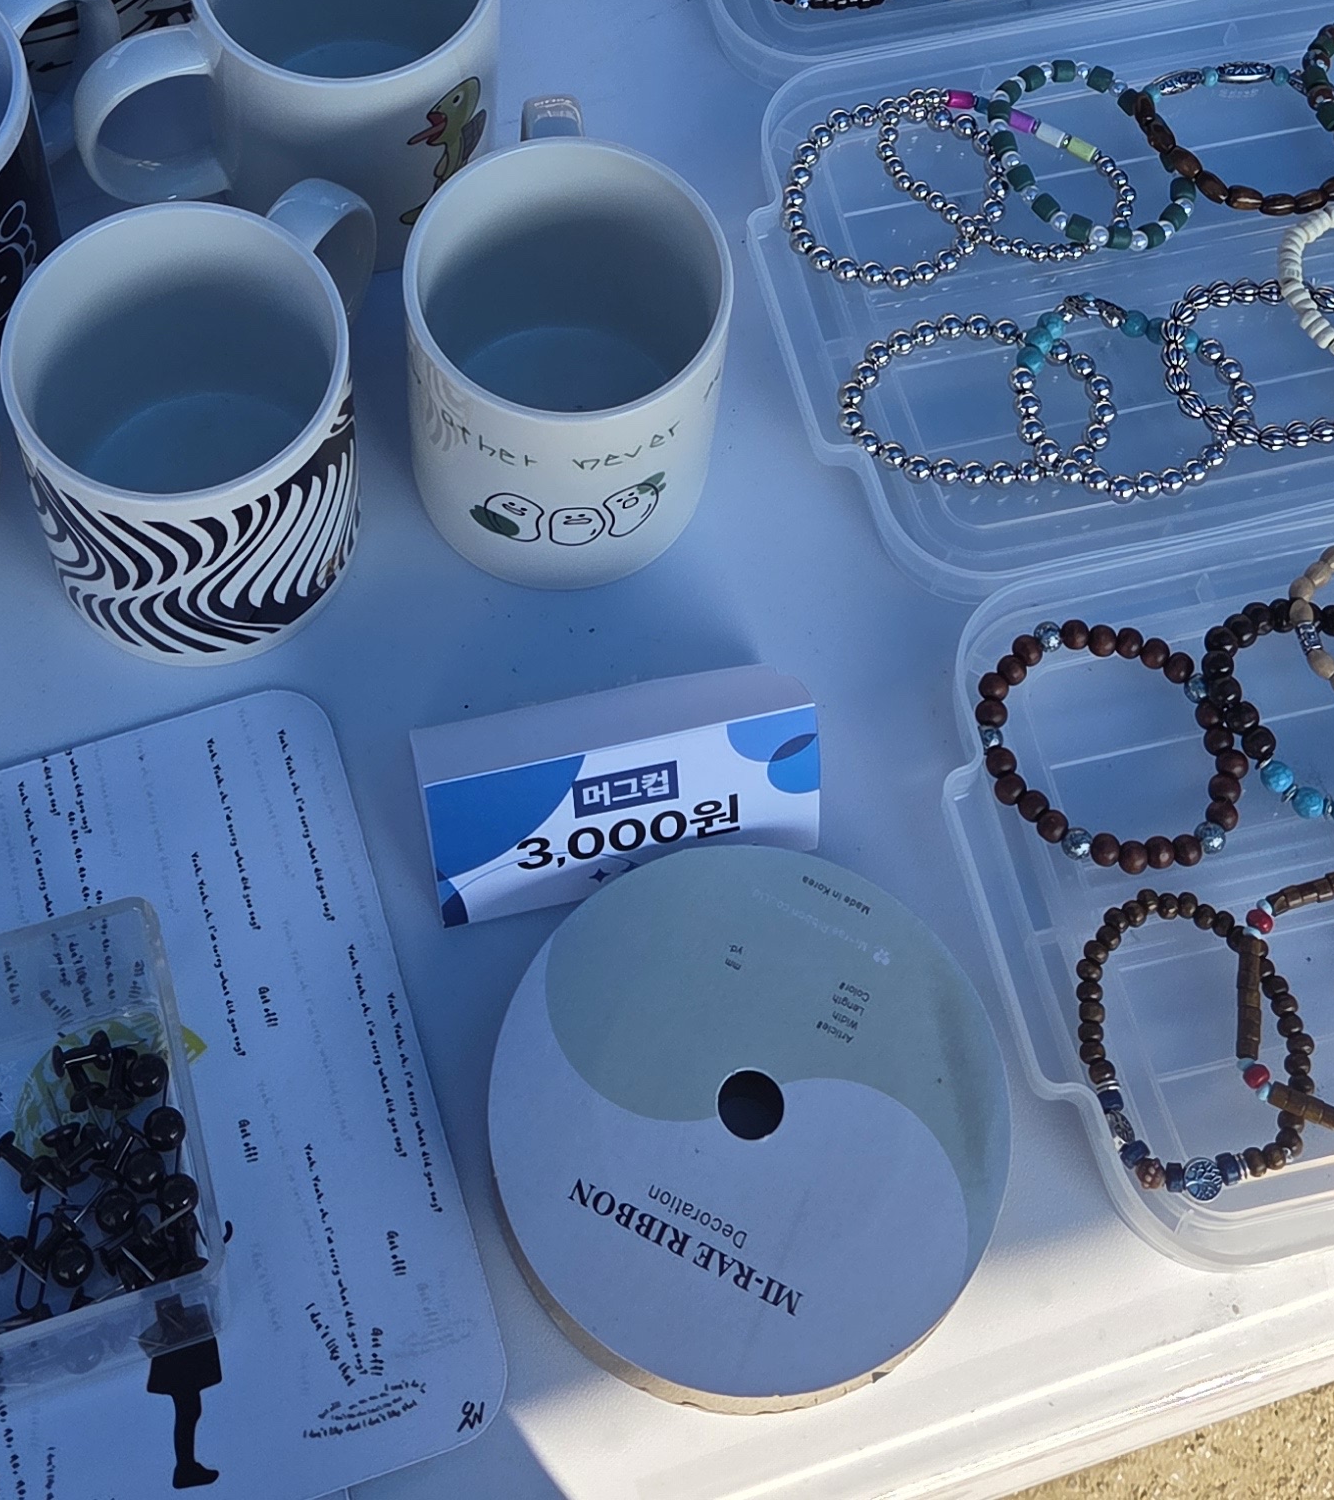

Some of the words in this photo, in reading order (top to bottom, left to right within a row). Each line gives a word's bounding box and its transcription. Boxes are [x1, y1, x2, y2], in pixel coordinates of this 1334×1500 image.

[571, 419, 681, 471] never
[581, 769, 670, 807] 머그컵
[516, 793, 741, 871] 3,000원
[802, 875, 831, 896] Korea
[832, 889, 842, 900] in
[843, 895, 871, 915] Made
[724, 958, 742, 970] mm
[832, 993, 865, 1016] Length
[832, 1010, 858, 1030] Width
[567, 1177, 692, 1259] RIBBON
[647, 1184, 748, 1250] Decoration
[692, 1241, 804, 1317] MI-RAE
